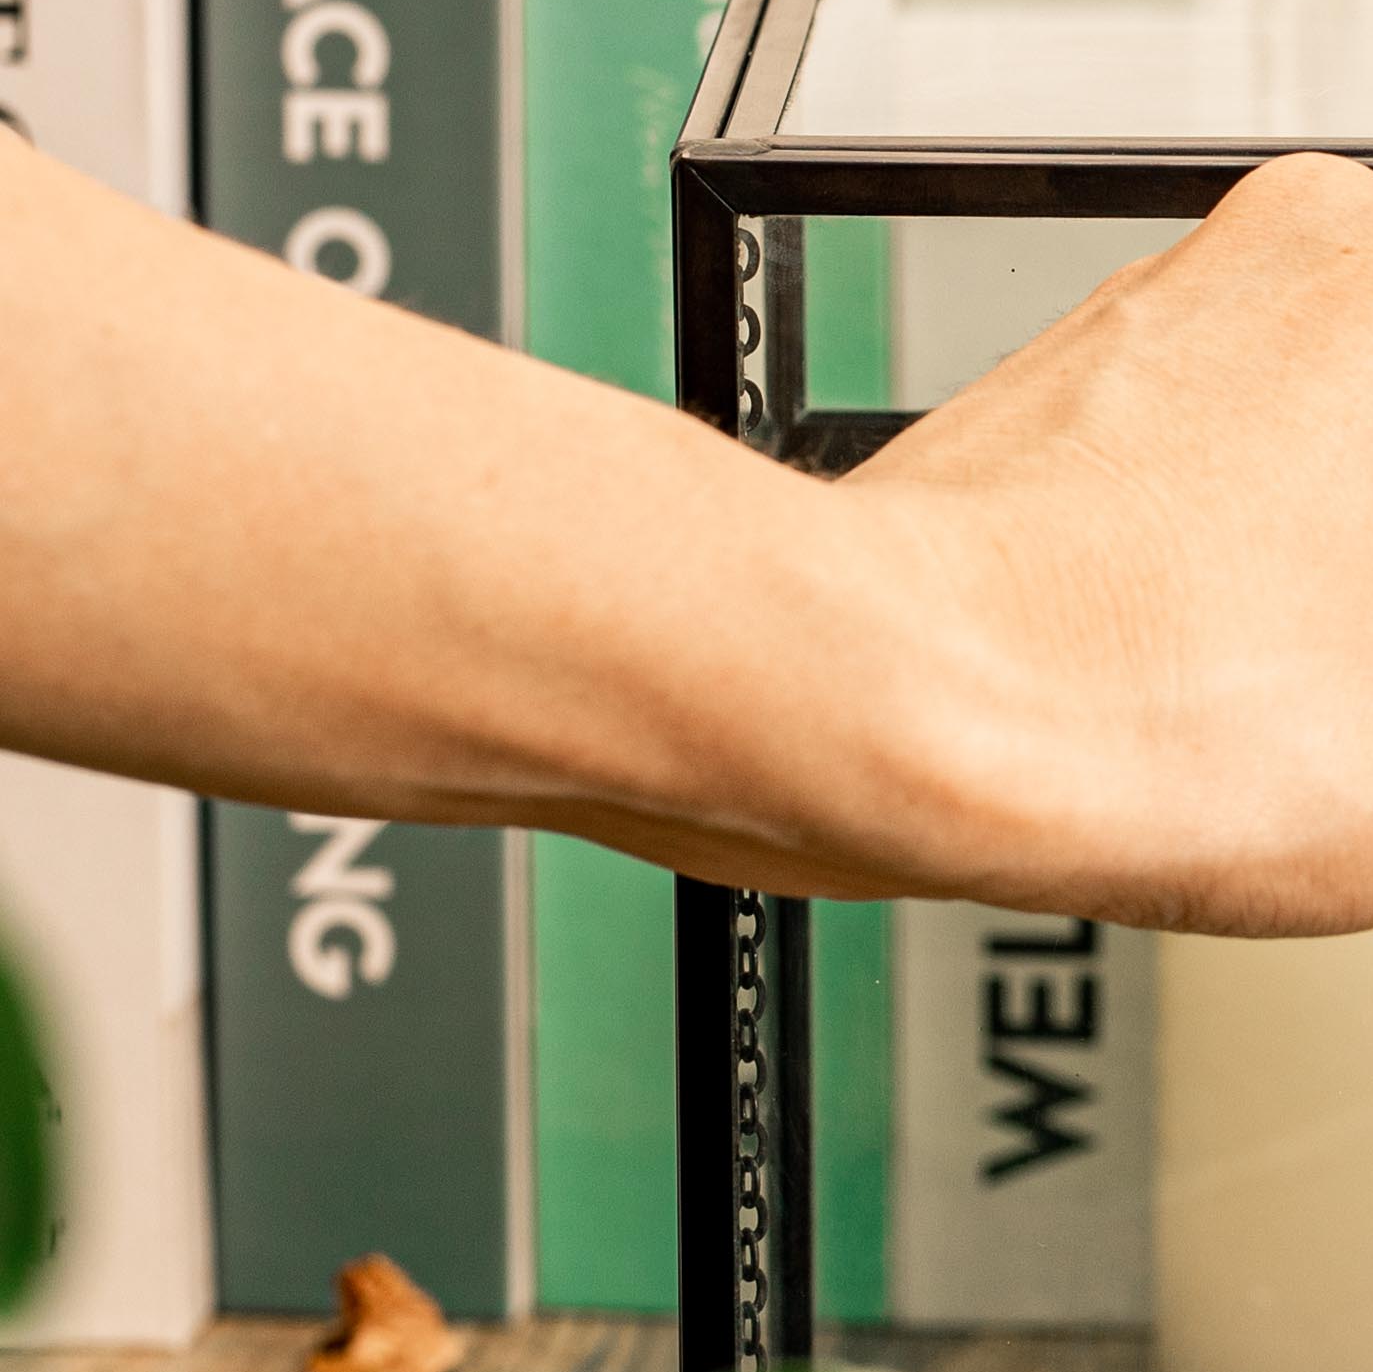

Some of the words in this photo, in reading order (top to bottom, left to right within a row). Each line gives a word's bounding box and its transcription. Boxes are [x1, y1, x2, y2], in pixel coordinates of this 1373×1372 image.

[283, 205, 392, 299] O
[287, 811, 396, 1002] NG
[977, 916, 1101, 1184] WEL
